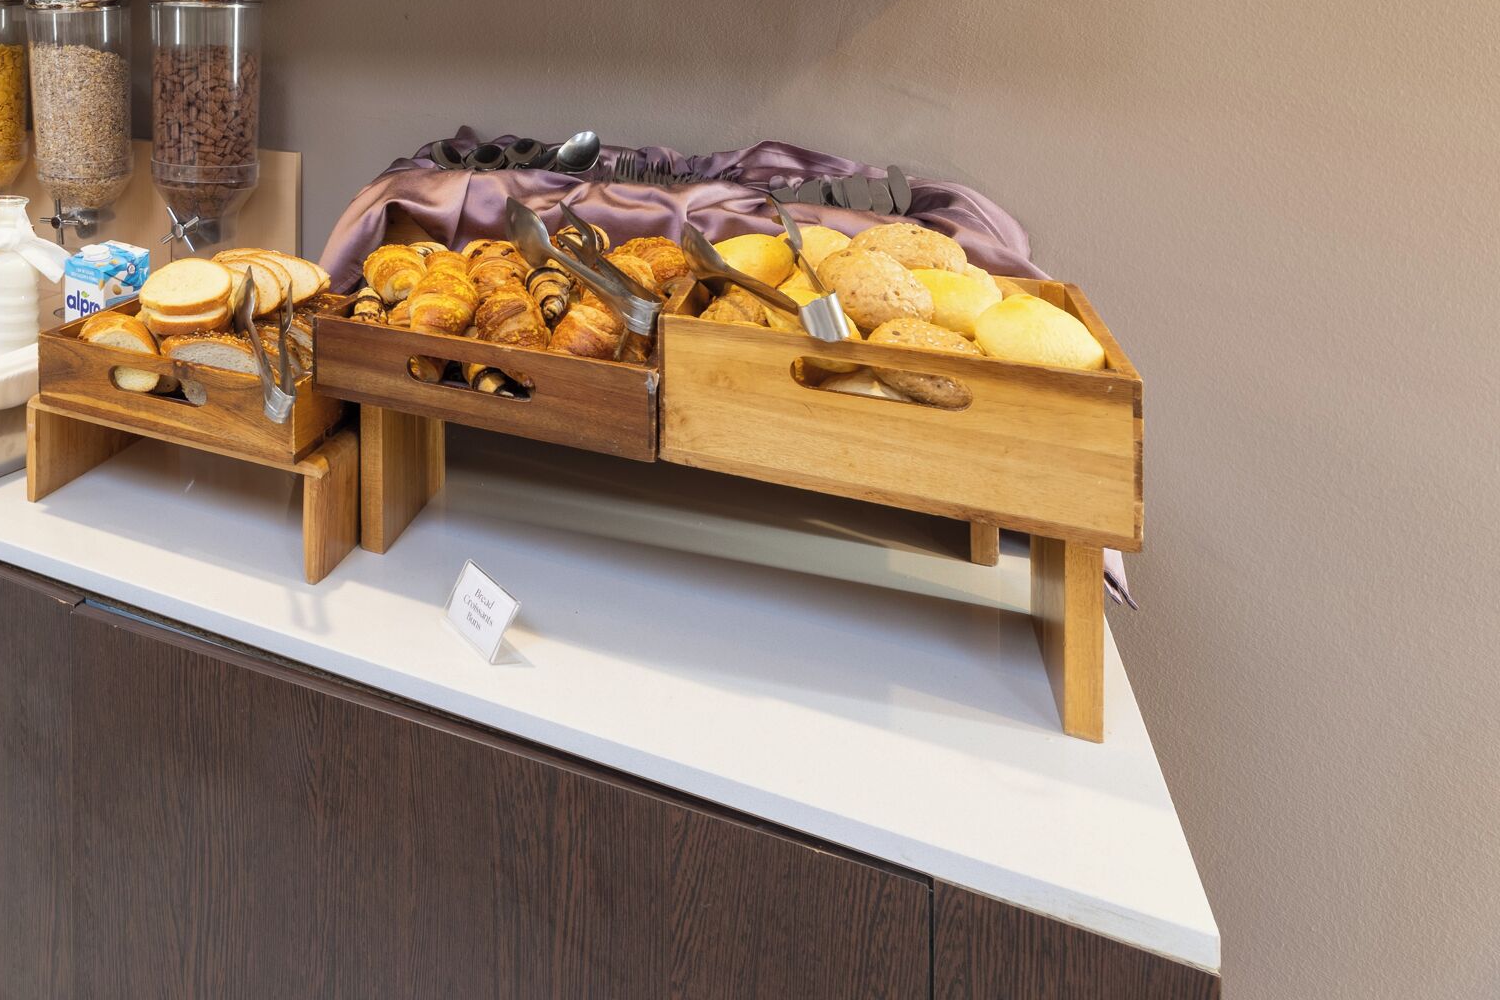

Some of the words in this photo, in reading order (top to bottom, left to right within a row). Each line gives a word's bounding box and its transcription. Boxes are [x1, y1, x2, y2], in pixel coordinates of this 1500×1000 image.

[66, 290, 100, 317] alpro
[463, 594, 494, 626] Croissants
[475, 588, 496, 610] Bread
[466, 611, 482, 630] Buns
